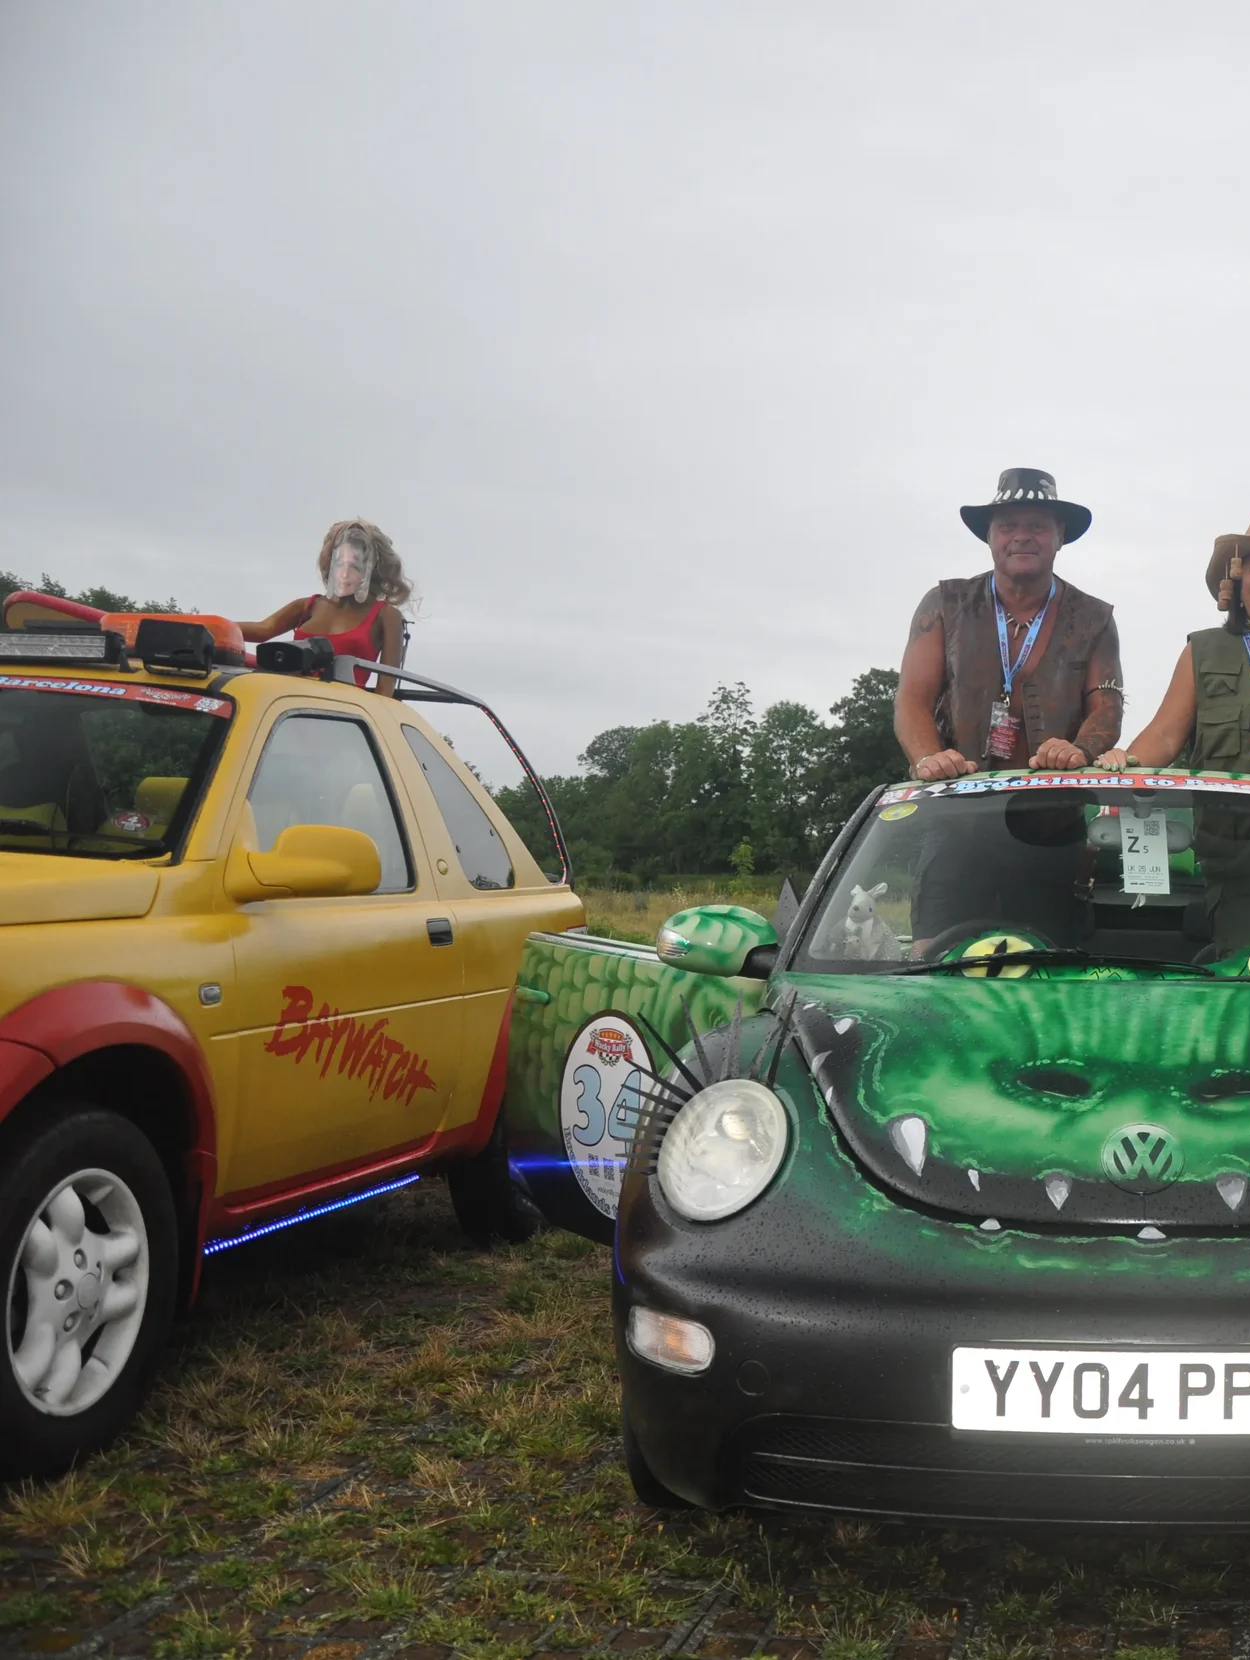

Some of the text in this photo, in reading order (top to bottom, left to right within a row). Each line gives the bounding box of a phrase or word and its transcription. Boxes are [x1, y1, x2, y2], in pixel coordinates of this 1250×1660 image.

[955, 775, 1134, 792] Brooklands
[1144, 778, 1176, 786] to
[1127, 835, 1140, 853] Z
[263, 985, 438, 1107] BAYWATCH
[572, 1063, 642, 1156] 34
[983, 1359, 1155, 1420] YY04
